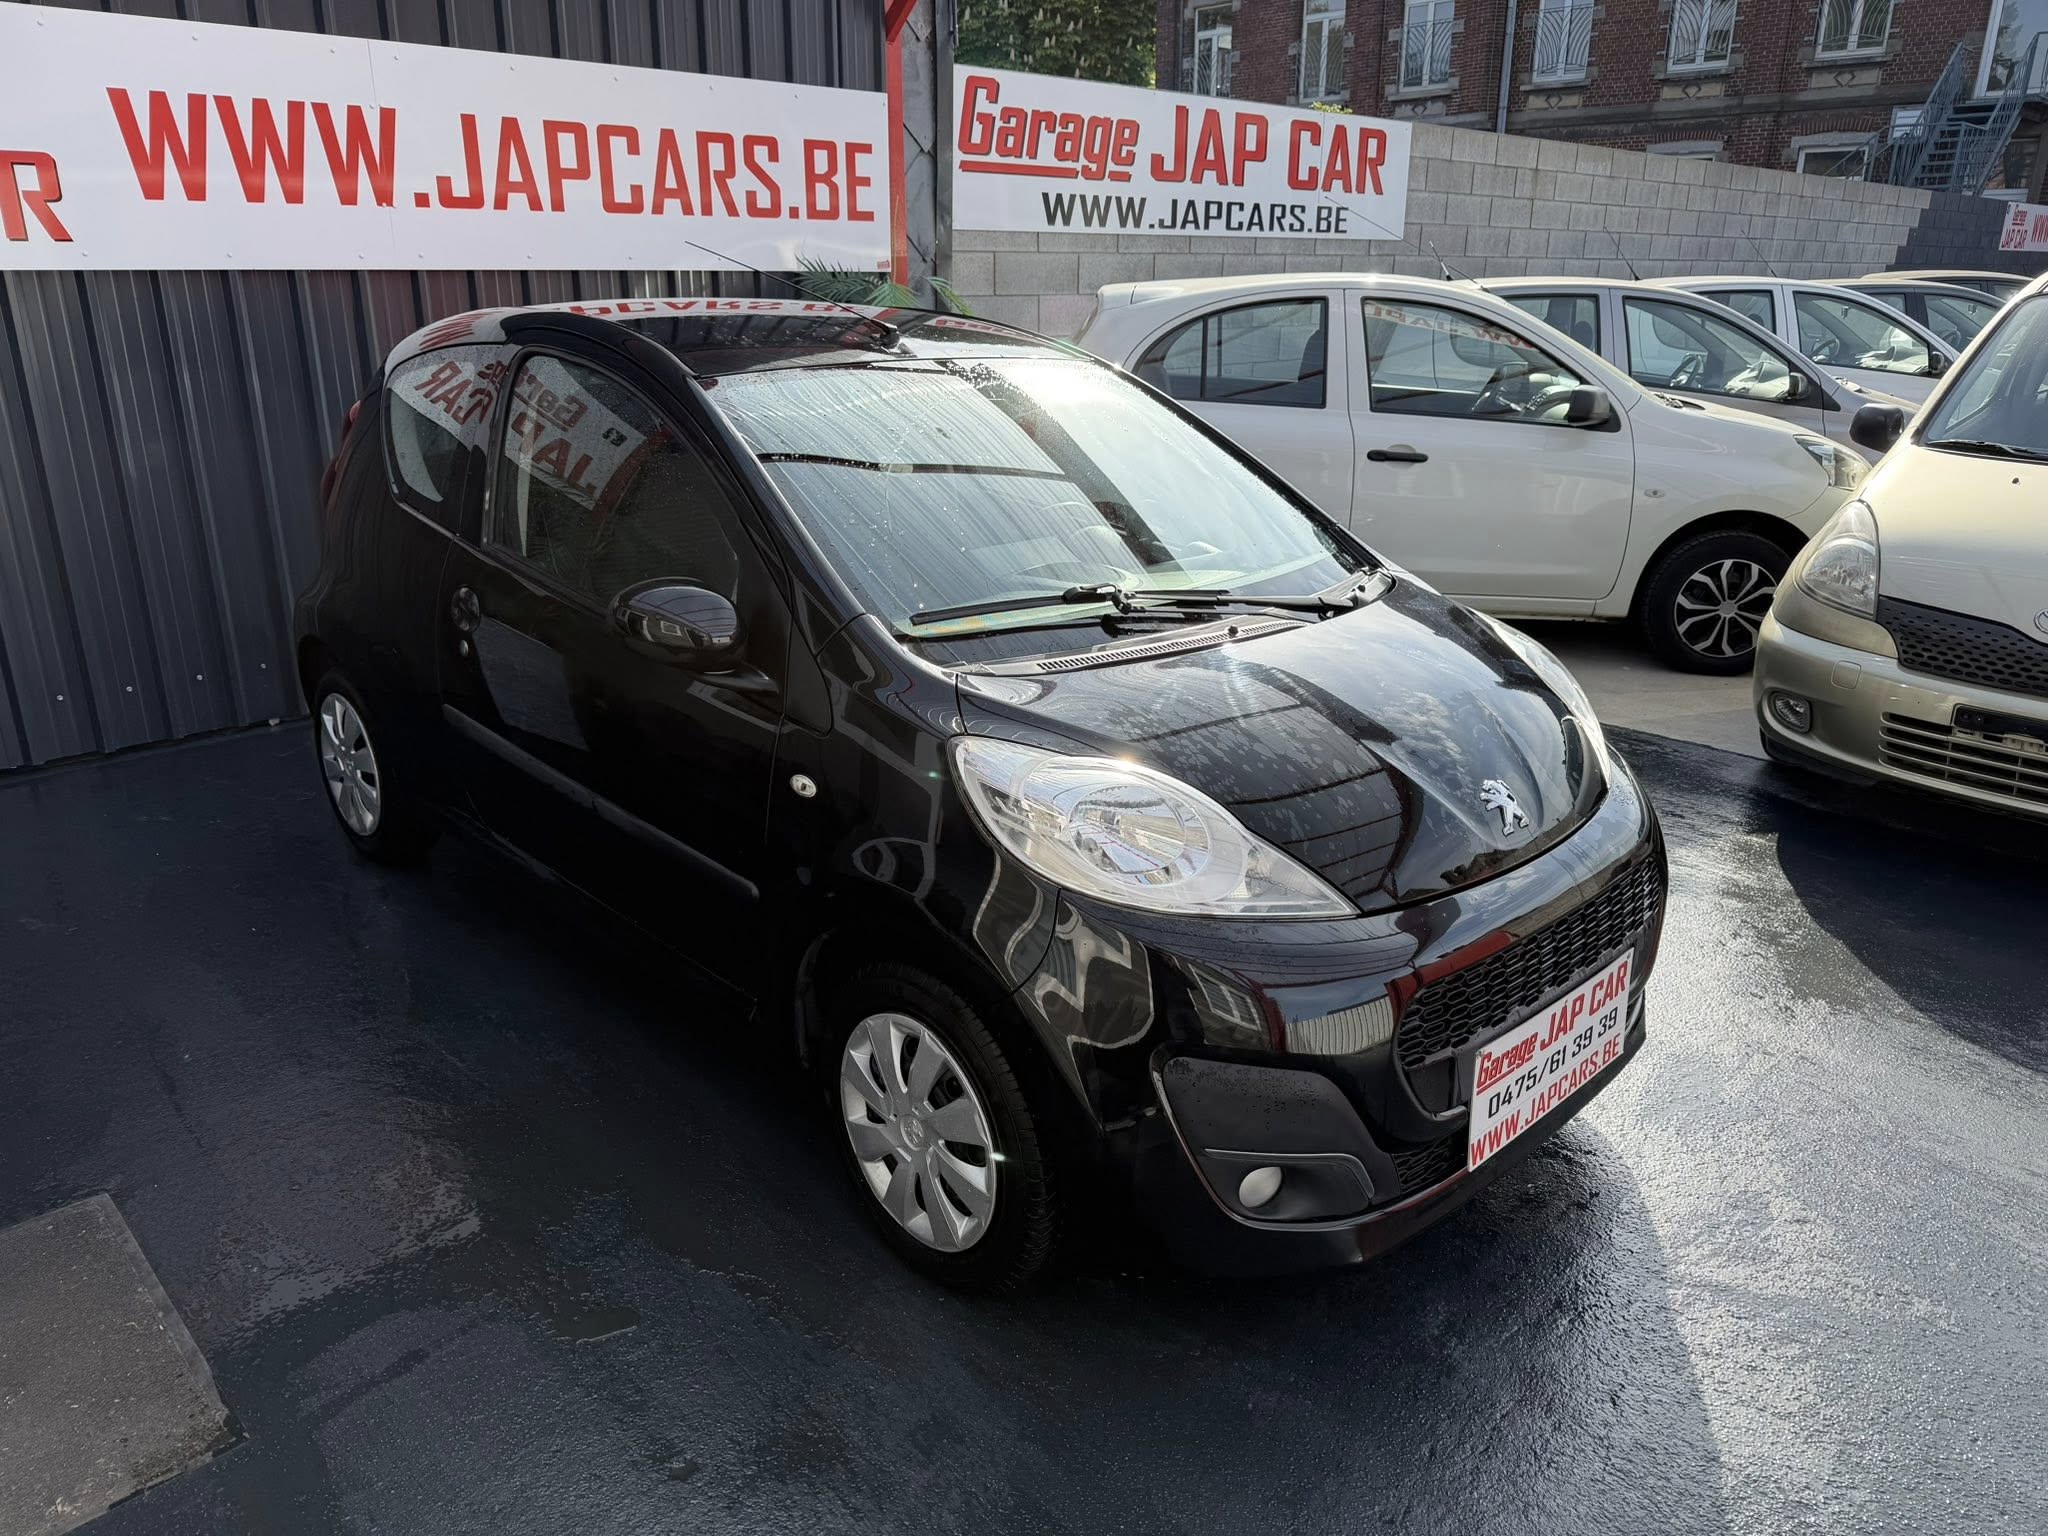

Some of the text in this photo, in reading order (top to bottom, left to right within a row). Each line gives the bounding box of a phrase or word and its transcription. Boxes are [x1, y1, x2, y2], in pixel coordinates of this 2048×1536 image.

[106, 87, 875, 222] WWW.JAPCARS.BE
[957, 75, 1387, 196] Garage JAP CAR
[1042, 192, 1349, 234] WWW.JAPCARS.BE
[1476, 960, 1629, 1094] Garage JAP CAR
[1488, 1006, 1618, 1119] 0475/61 39 39
[1470, 1032, 1621, 1167] WWW.JAPCARS.BE
